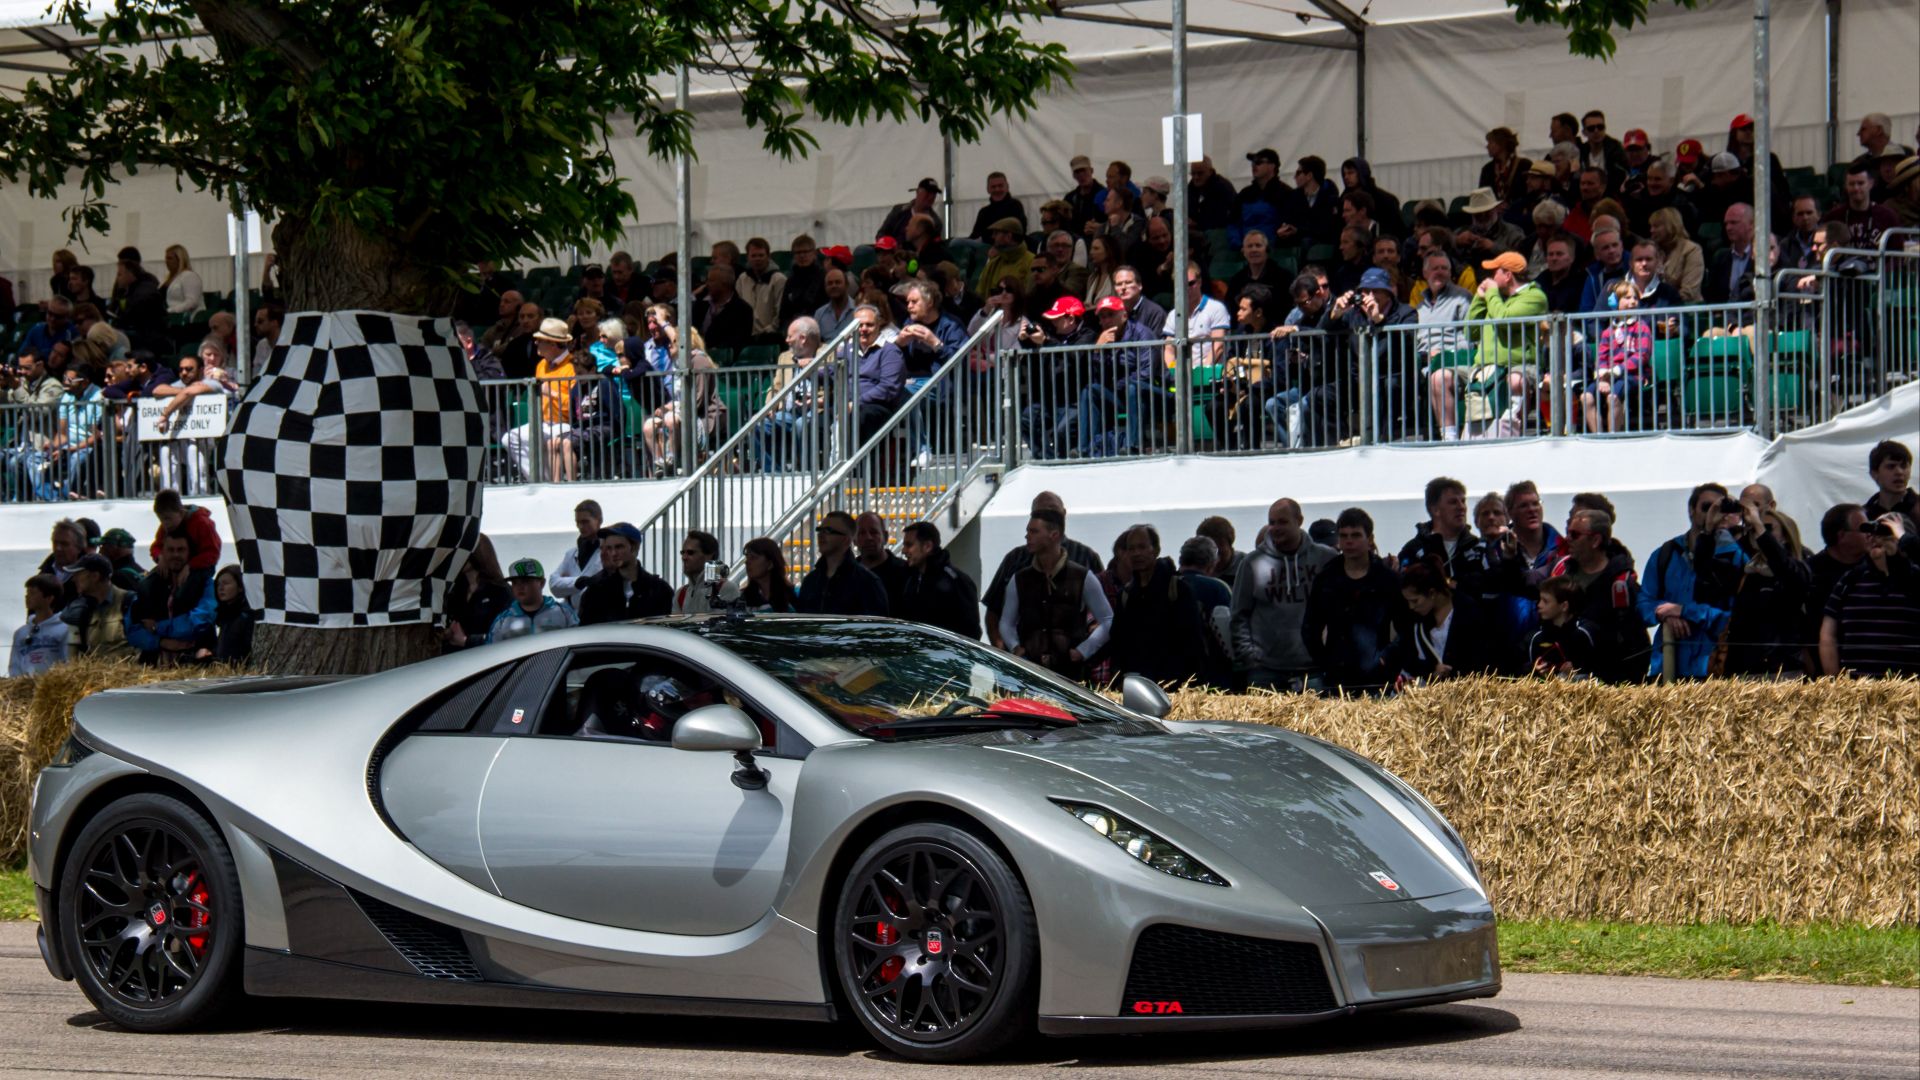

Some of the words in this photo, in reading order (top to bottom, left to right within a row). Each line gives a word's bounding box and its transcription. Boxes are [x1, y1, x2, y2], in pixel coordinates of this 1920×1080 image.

[196, 404, 222, 415] TICKET
[191, 419, 211, 430] ONLY
[1133, 1001, 1184, 1014] GTA
